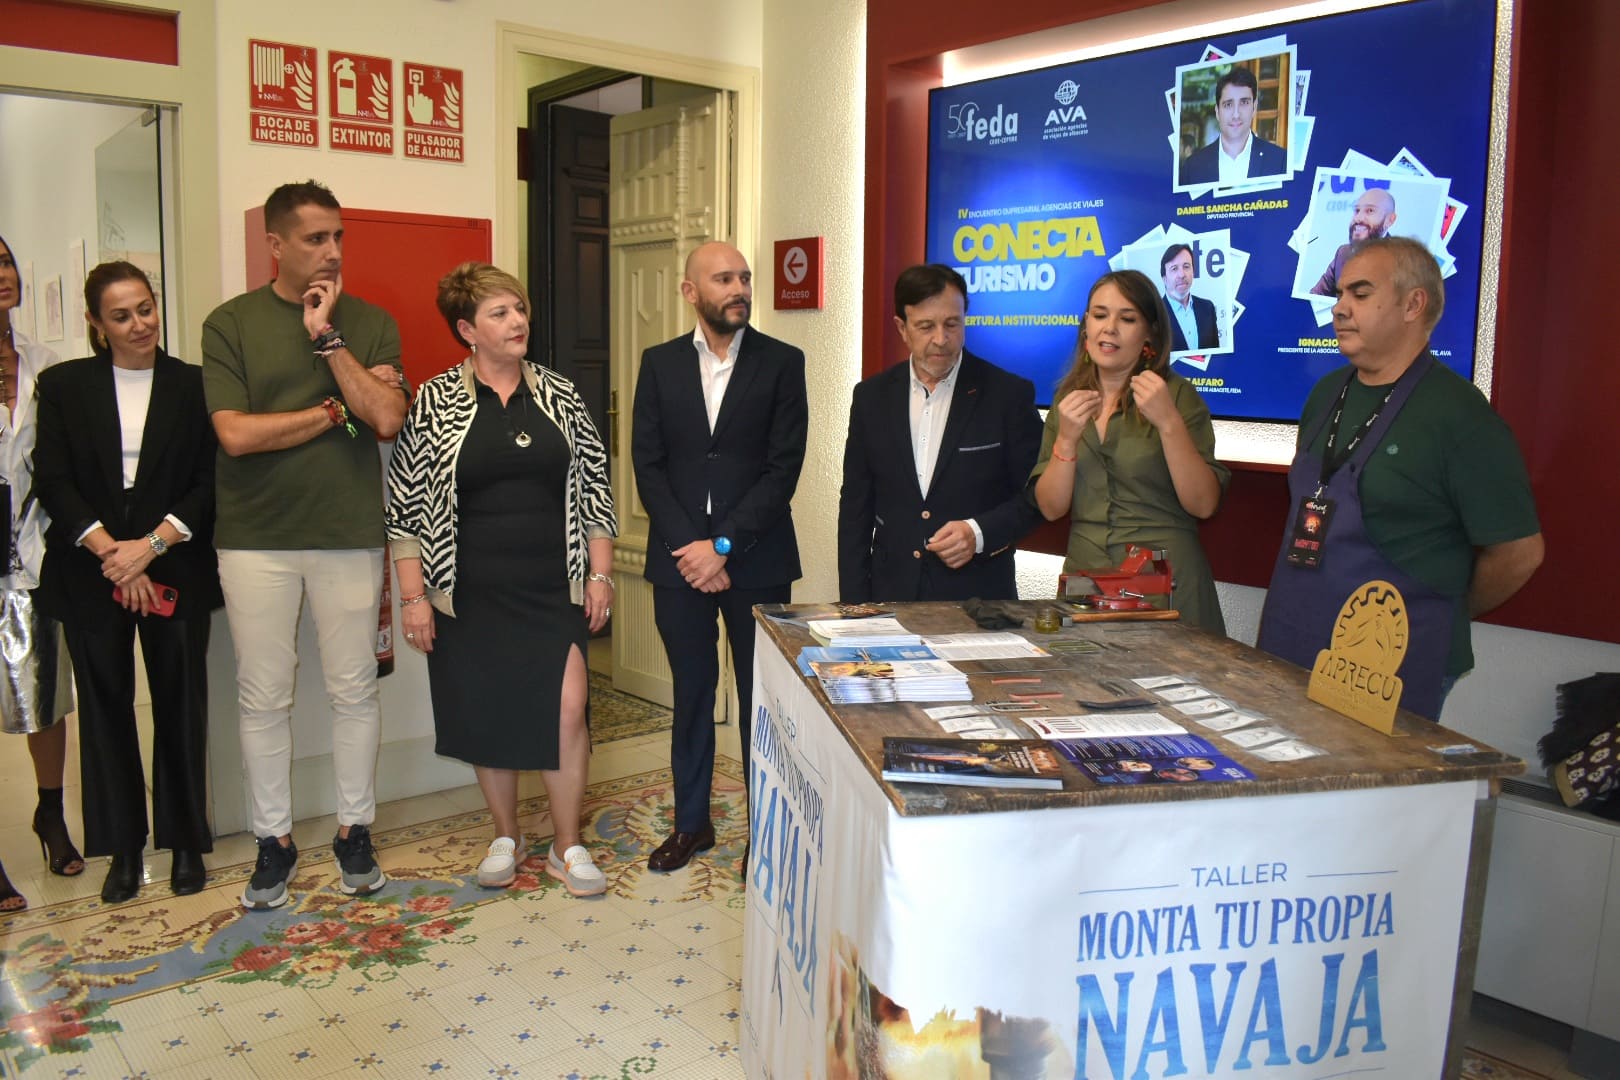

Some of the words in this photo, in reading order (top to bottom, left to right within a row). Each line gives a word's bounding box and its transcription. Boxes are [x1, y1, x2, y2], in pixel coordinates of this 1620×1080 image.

[259, 115, 292, 130] BOCA
[295, 119, 311, 132] DE
[966, 103, 1018, 142] feda
[1044, 105, 1087, 126] AVA
[255, 128, 314, 145] INCENDIO
[332, 127, 392, 149] EXTINTOR
[407, 132, 461, 149] PULSADOR
[407, 144, 421, 155] DE
[422, 146, 461, 160] ALARMA
[958, 208, 969, 219] IV
[1041, 202, 1072, 213] AGENCIAS
[1072, 200, 1082, 209] DE
[1082, 199, 1104, 209] VIAJES
[1176, 206, 1205, 216] DANIEL
[1206, 203, 1243, 213] SANCHA
[1243, 200, 1289, 211] CAÑADAS
[952, 215, 1106, 263] CONECTA
[781, 288, 810, 300] Acceso
[964, 315, 1001, 327] ERTURA
[1002, 313, 1081, 326] INSTITUCIONAL
[1298, 338, 1339, 347] IGNACIO
[1191, 377, 1224, 387] ALFARO
[1319, 656, 1397, 702] APRECU
[1190, 862, 1288, 888] TALLER
[1076, 903, 1202, 963] MONTA
[1215, 900, 1261, 950] TU
[1268, 891, 1395, 945] PROPIA
[1073, 948, 1387, 1080] NAVAJA
